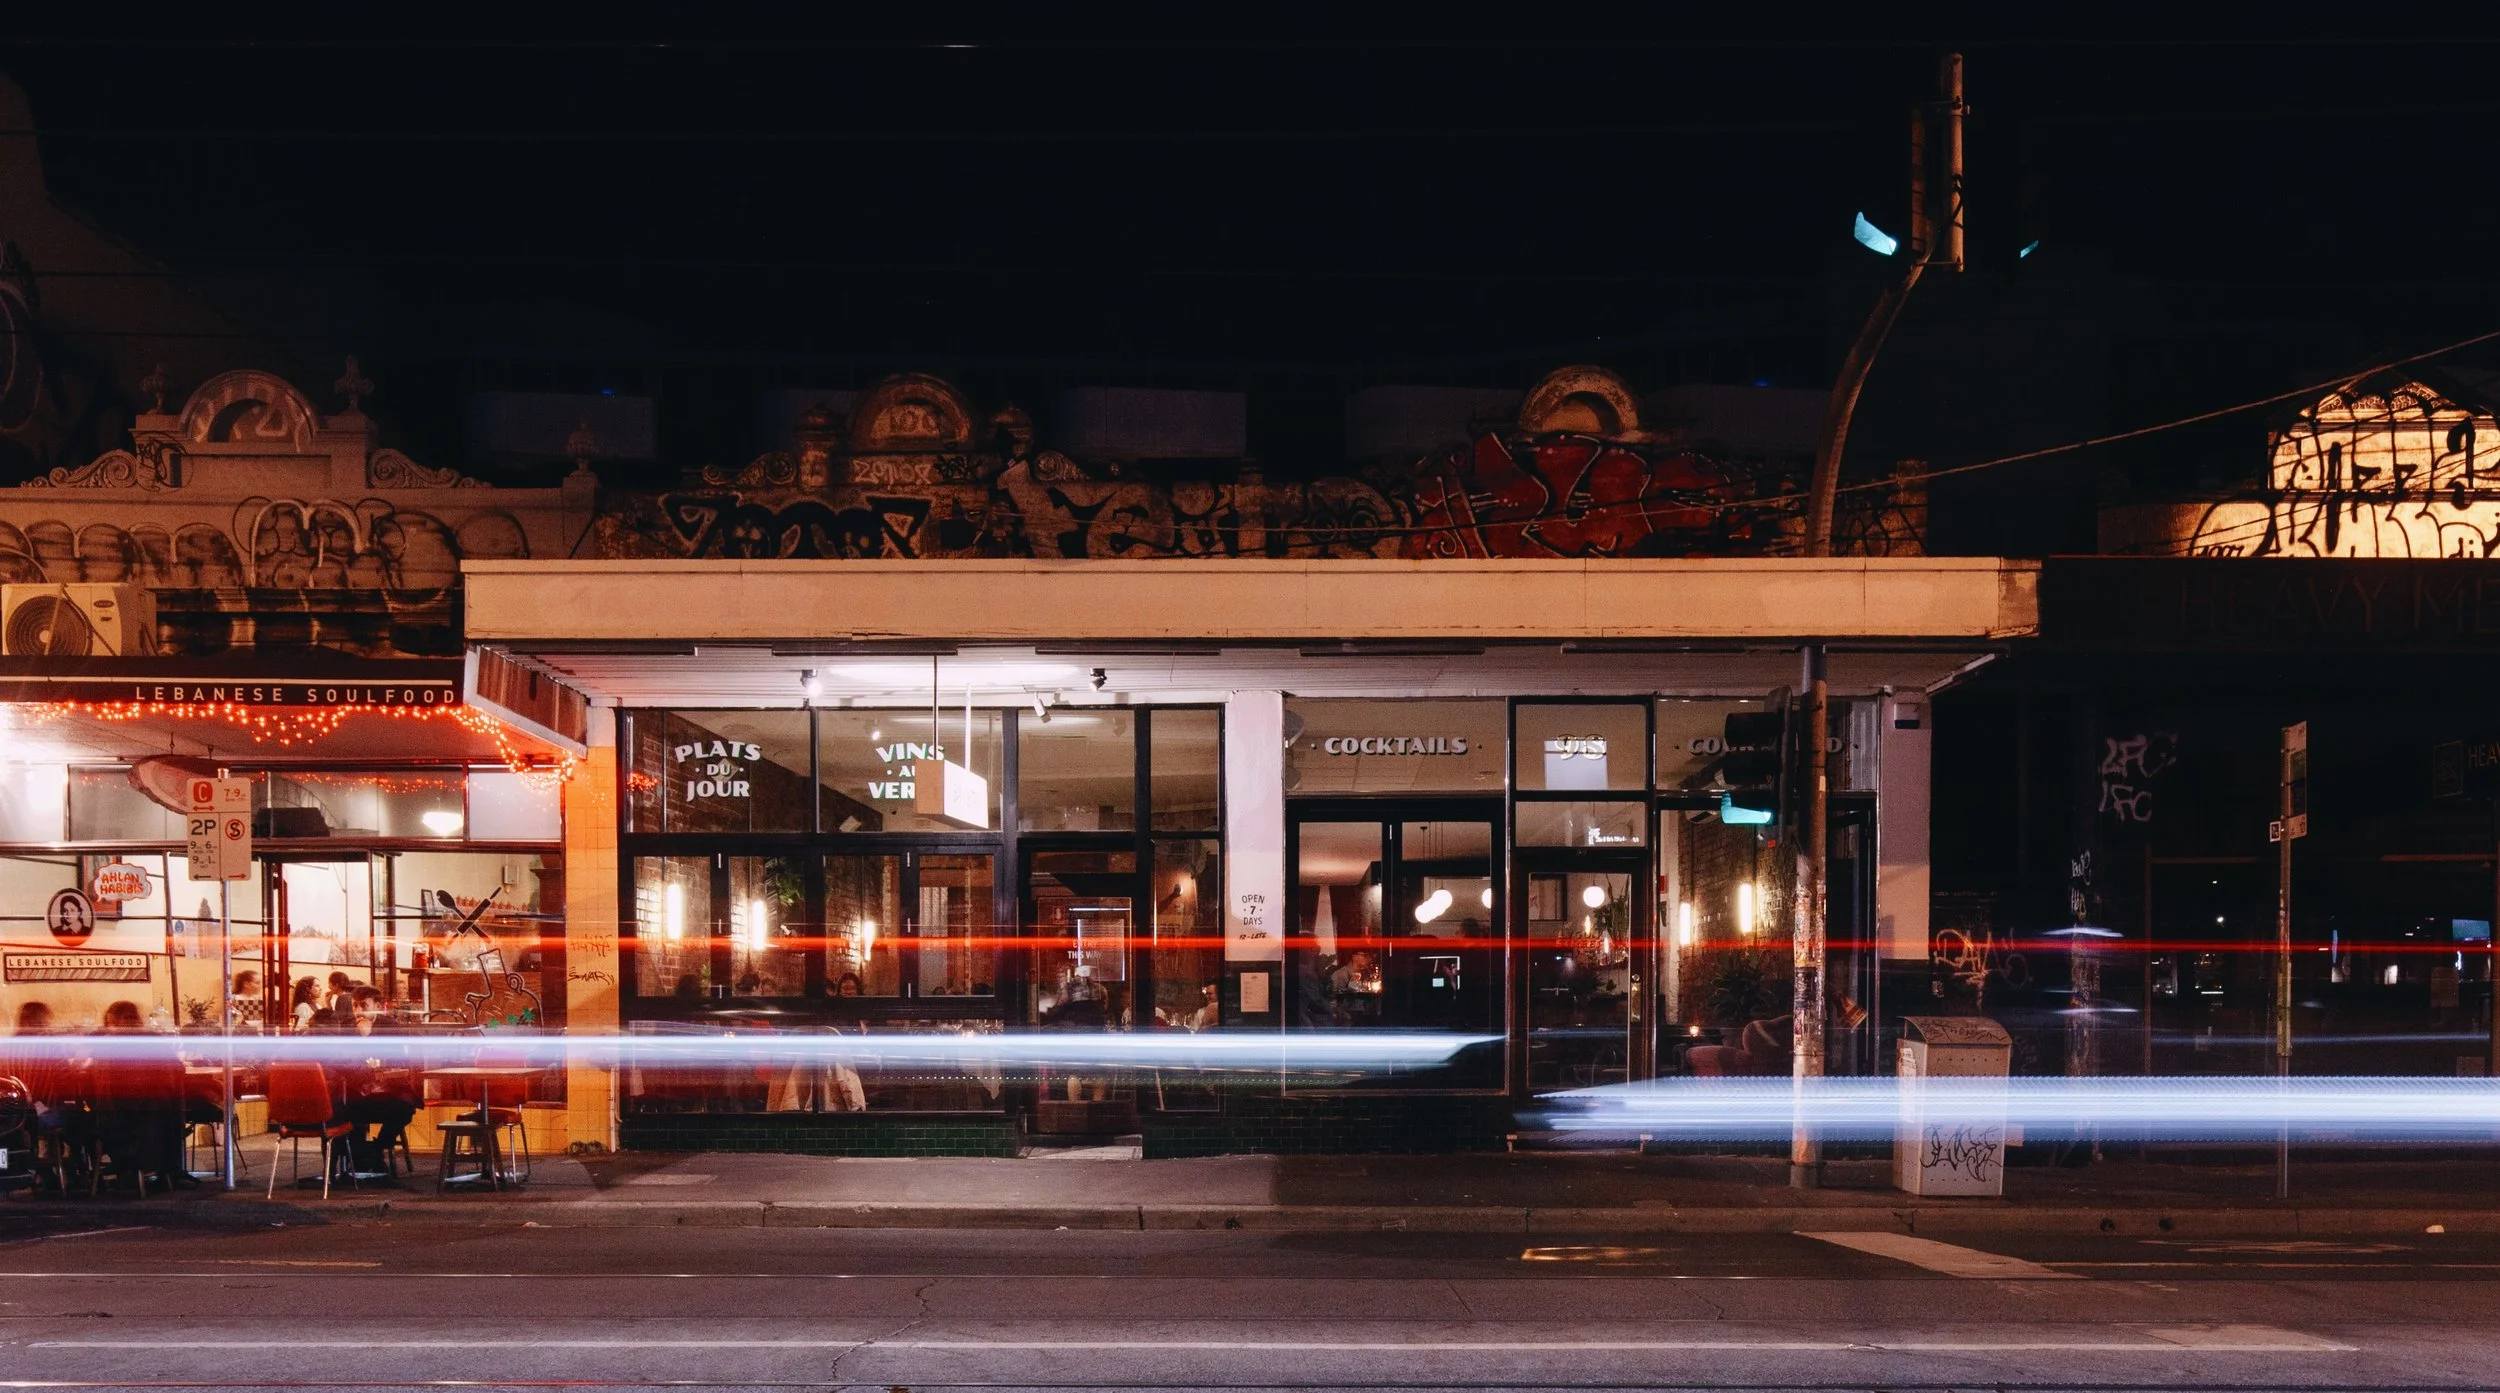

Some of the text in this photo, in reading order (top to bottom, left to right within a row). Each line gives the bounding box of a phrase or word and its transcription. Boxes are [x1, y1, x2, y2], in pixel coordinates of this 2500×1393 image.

[135, 686, 455, 704] LEBANESE SOULFOOD
[675, 740, 762, 763] PLATS
[875, 742, 945, 763] VINS
[1324, 736, 1469, 756] COCKTAILS
[706, 763, 732, 776] DU
[898, 765, 916, 778] A
[686, 780, 750, 803] JOUR
[190, 819, 217, 836] 2P
[102, 871, 140, 884] AHLAN
[100, 882, 144, 895] HABIBIS
[1241, 894, 1265, 904] OPEN
[1250, 905, 1256, 915] 7
[1243, 916, 1263, 926] DAYS
[8, 957, 143, 967] LEBANESE SOULFOOD
